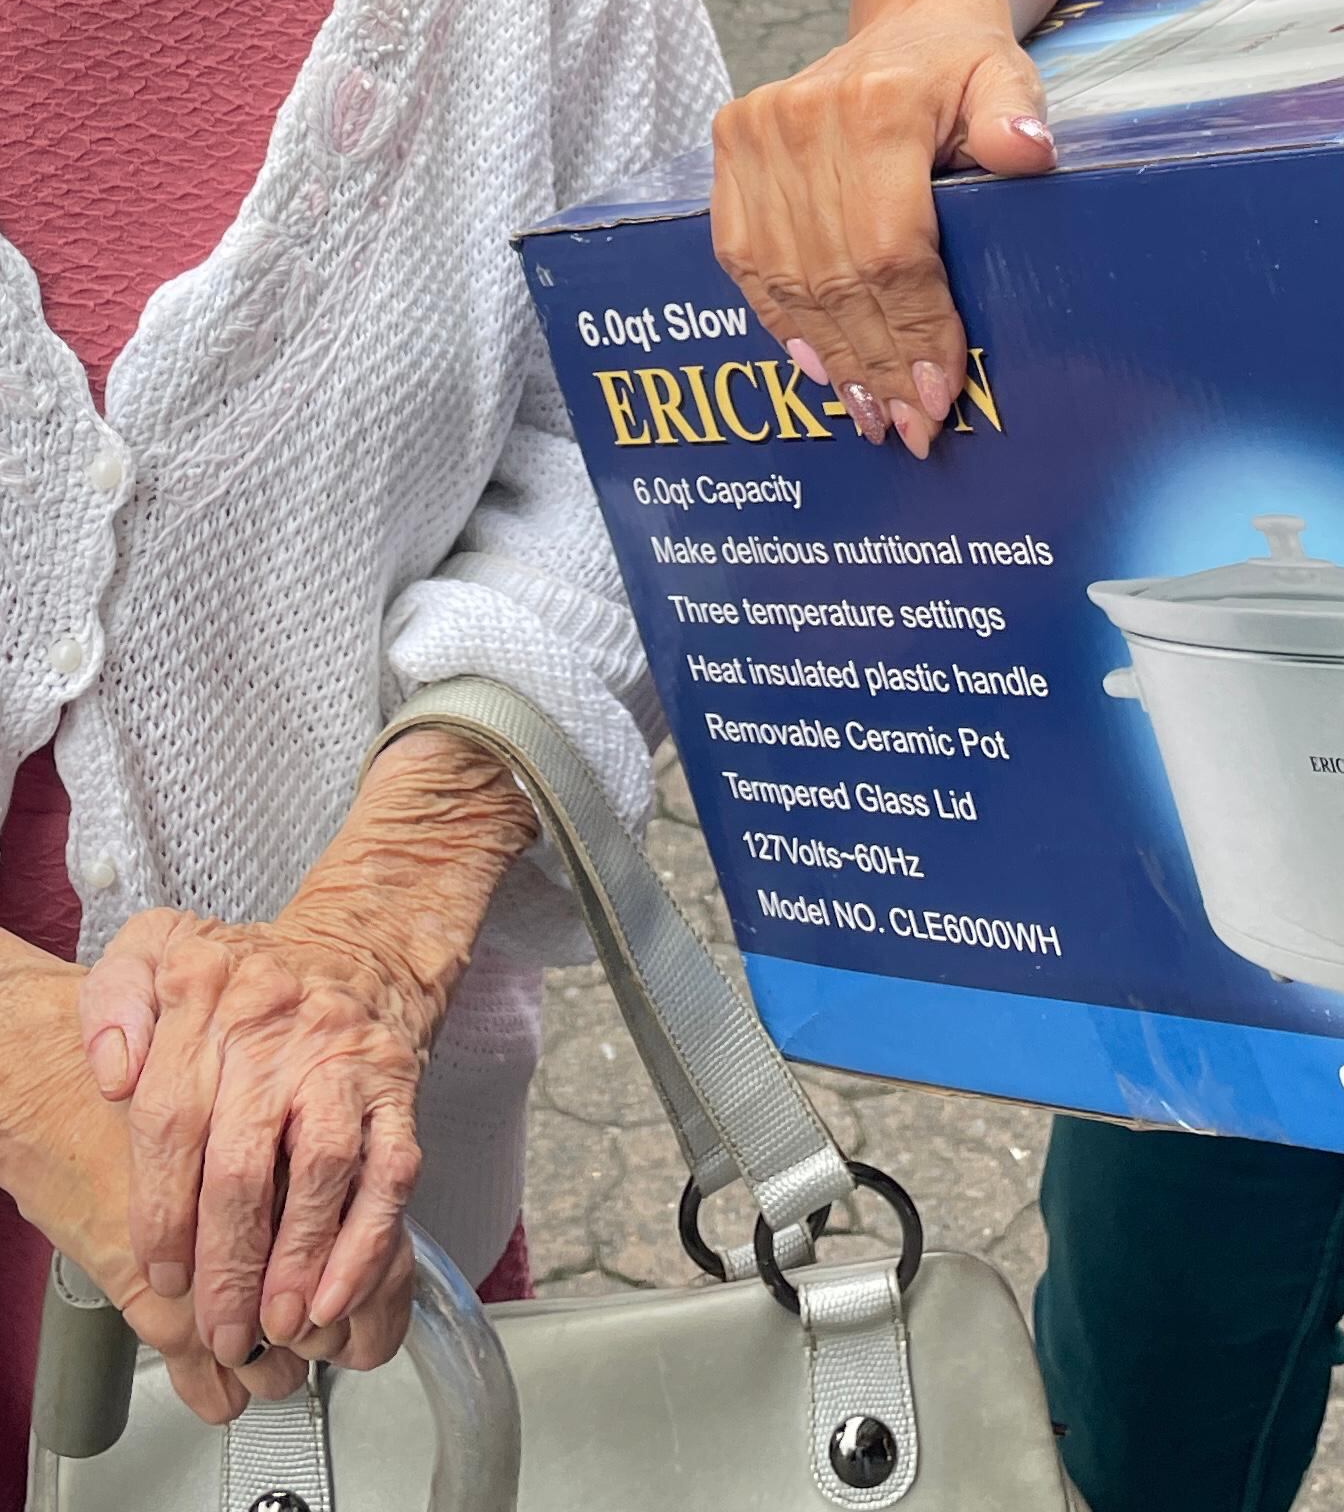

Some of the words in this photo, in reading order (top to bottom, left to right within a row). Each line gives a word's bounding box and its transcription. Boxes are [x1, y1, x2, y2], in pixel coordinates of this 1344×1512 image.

[578, 307, 661, 352] 6.0qt
[663, 302, 748, 339] Slow
[592, 347, 1003, 446] ERICK-N
[633, 476, 695, 511] 6.0qt
[696, 474, 802, 510] Capacity
[651, 536, 718, 564] Make
[721, 536, 829, 565] delicious
[834, 534, 963, 565] nutritional
[968, 534, 1054, 566] meals
[668, 595, 739, 625] Three
[742, 598, 895, 632] temperature
[901, 598, 1006, 638] settings
[687, 654, 743, 685] Heat
[746, 656, 860, 690] insulated
[864, 661, 950, 697] plastic
[952, 664, 1049, 698] handle
[705, 712, 841, 750] Removable
[845, 720, 956, 758] Ceramic
[958, 727, 1010, 760] Pot
[722, 771, 850, 812] Termpered
[855, 782, 931, 818] Glass
[933, 789, 977, 822] Lid
[757, 890, 831, 929] Model
[833, 904, 886, 935] NO.
[889, 907, 1063, 957] CLE6000WH
